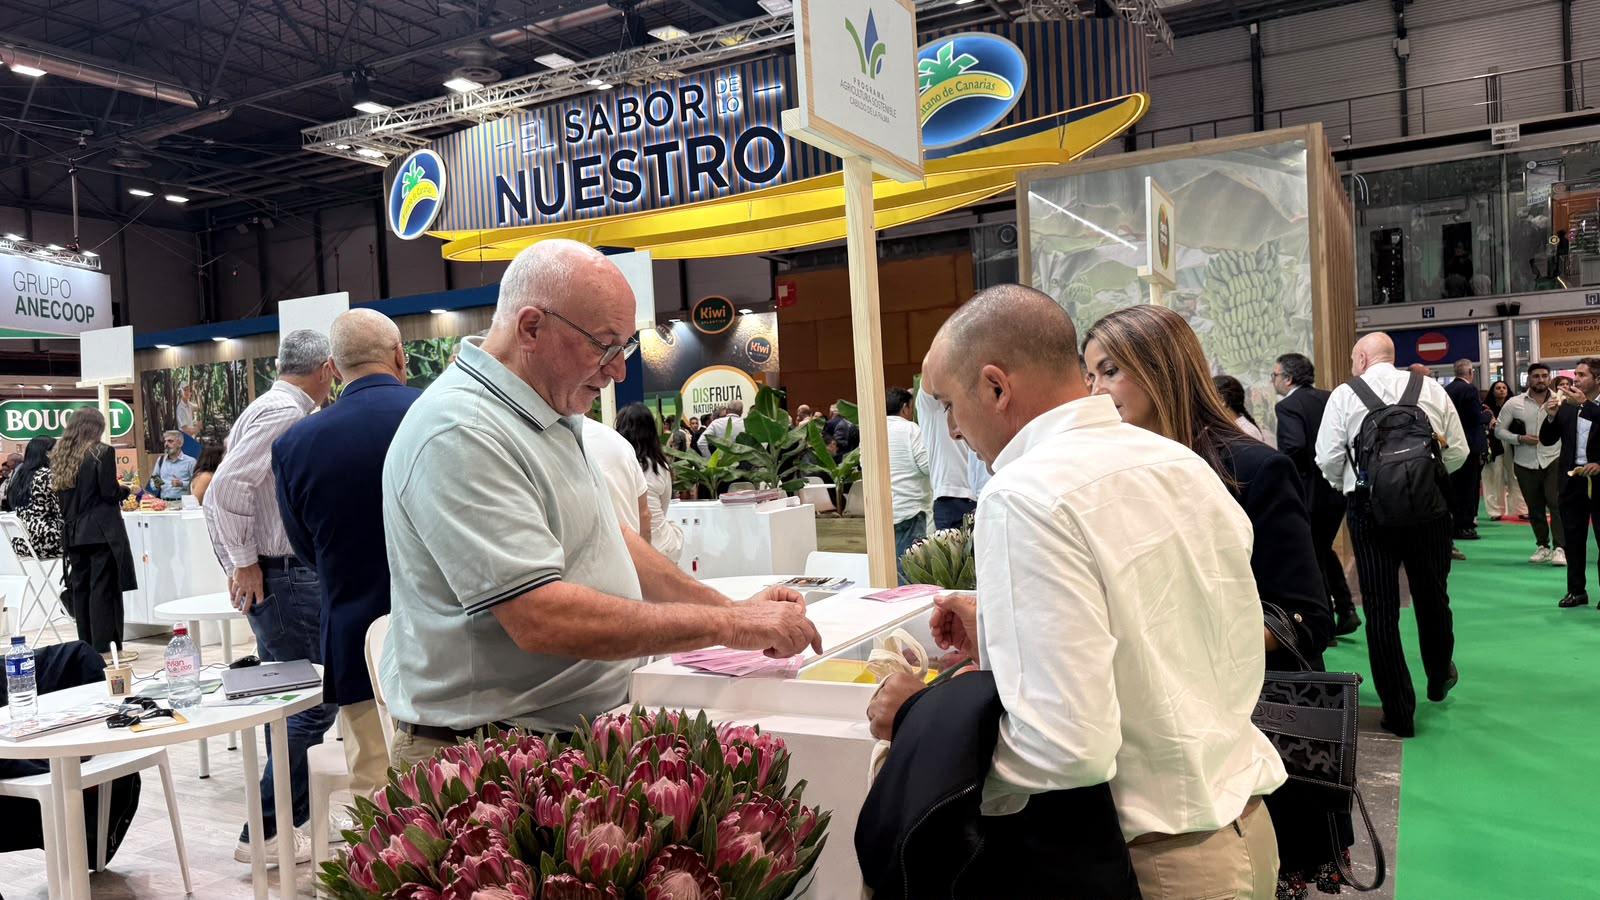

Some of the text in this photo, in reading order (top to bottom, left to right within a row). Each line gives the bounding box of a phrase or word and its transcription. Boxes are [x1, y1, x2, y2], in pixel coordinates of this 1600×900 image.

[716, 76, 740, 95] DE
[942, 86, 955, 98] de
[955, 78, 996, 92] Canarias
[717, 96, 740, 115] LO
[521, 83, 706, 154] EL SABOR
[497, 125, 787, 225] NUESTRO
[13, 271, 71, 299] GRUPO
[15, 295, 95, 324] ANECOOP
[700, 305, 726, 320] Kiwi
[751, 341, 770, 354] Kiwi
[692, 384, 743, 404] DISFRUTA
[5, 408, 123, 432] BOUT
